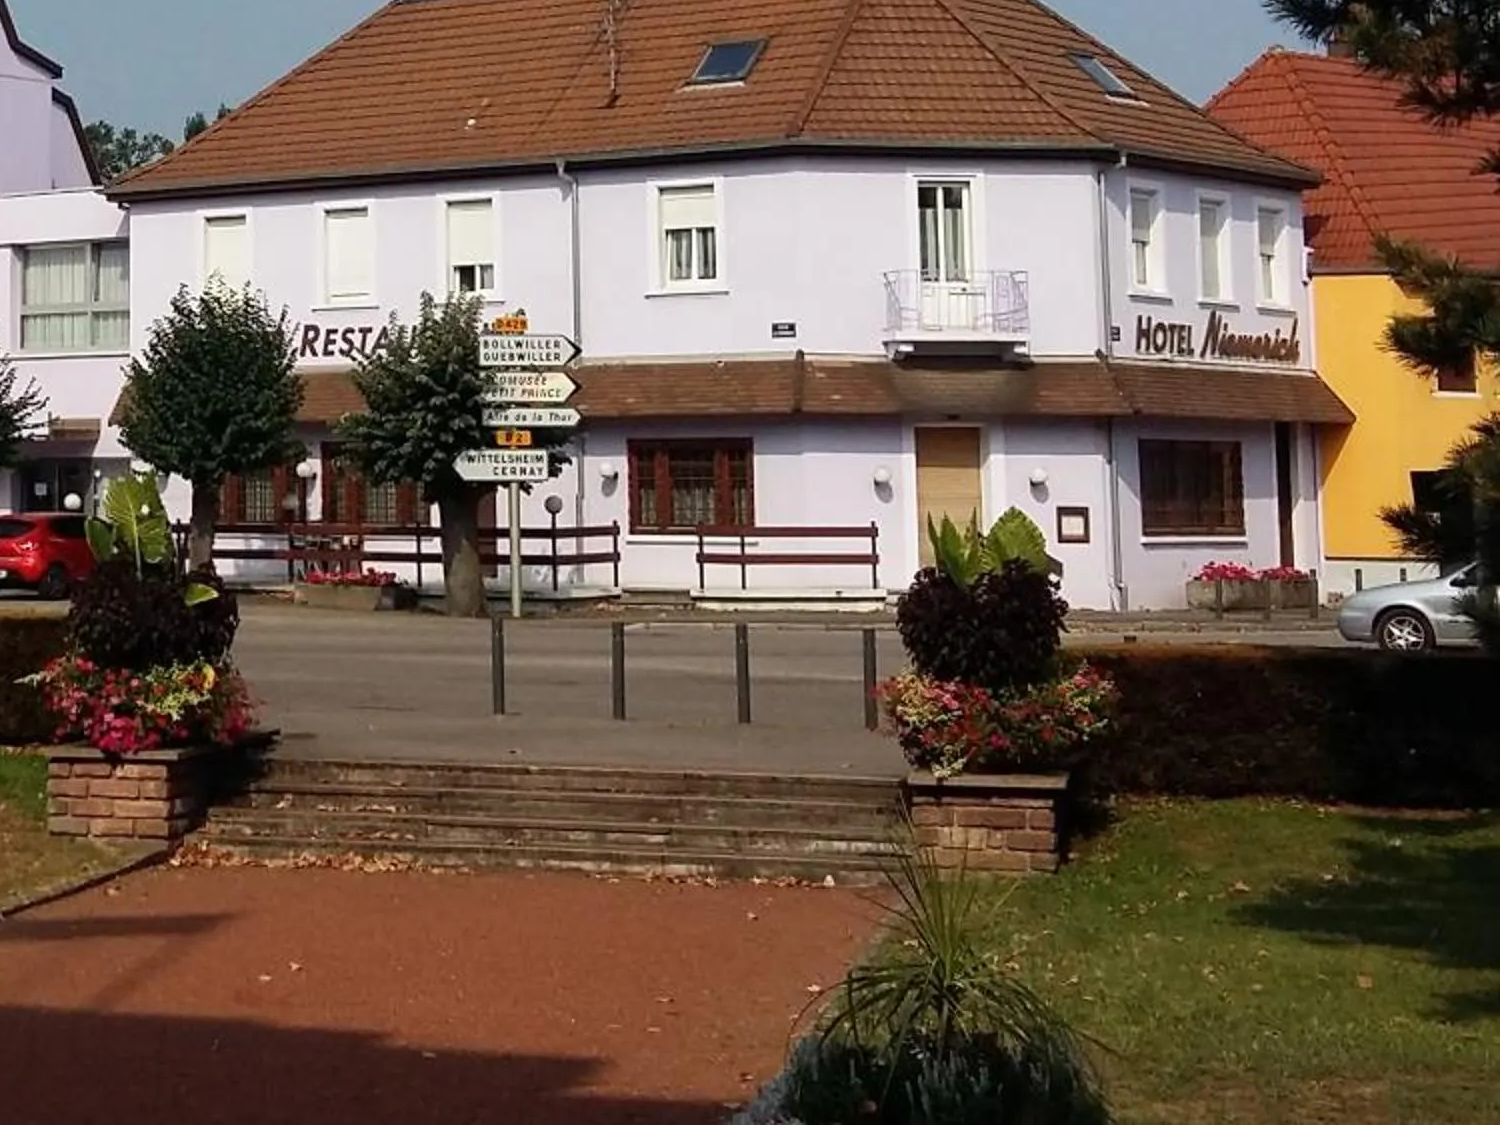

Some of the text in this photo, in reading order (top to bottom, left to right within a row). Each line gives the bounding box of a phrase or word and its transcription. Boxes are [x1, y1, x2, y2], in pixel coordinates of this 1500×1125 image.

[1136, 315, 1195, 357] HOTEL
[483, 339, 561, 350] BOLLWILLER
[483, 352, 561, 362] GUEBWILLER
[467, 454, 545, 464] WITTELSHEIM
[493, 466, 545, 476] CERNAY
